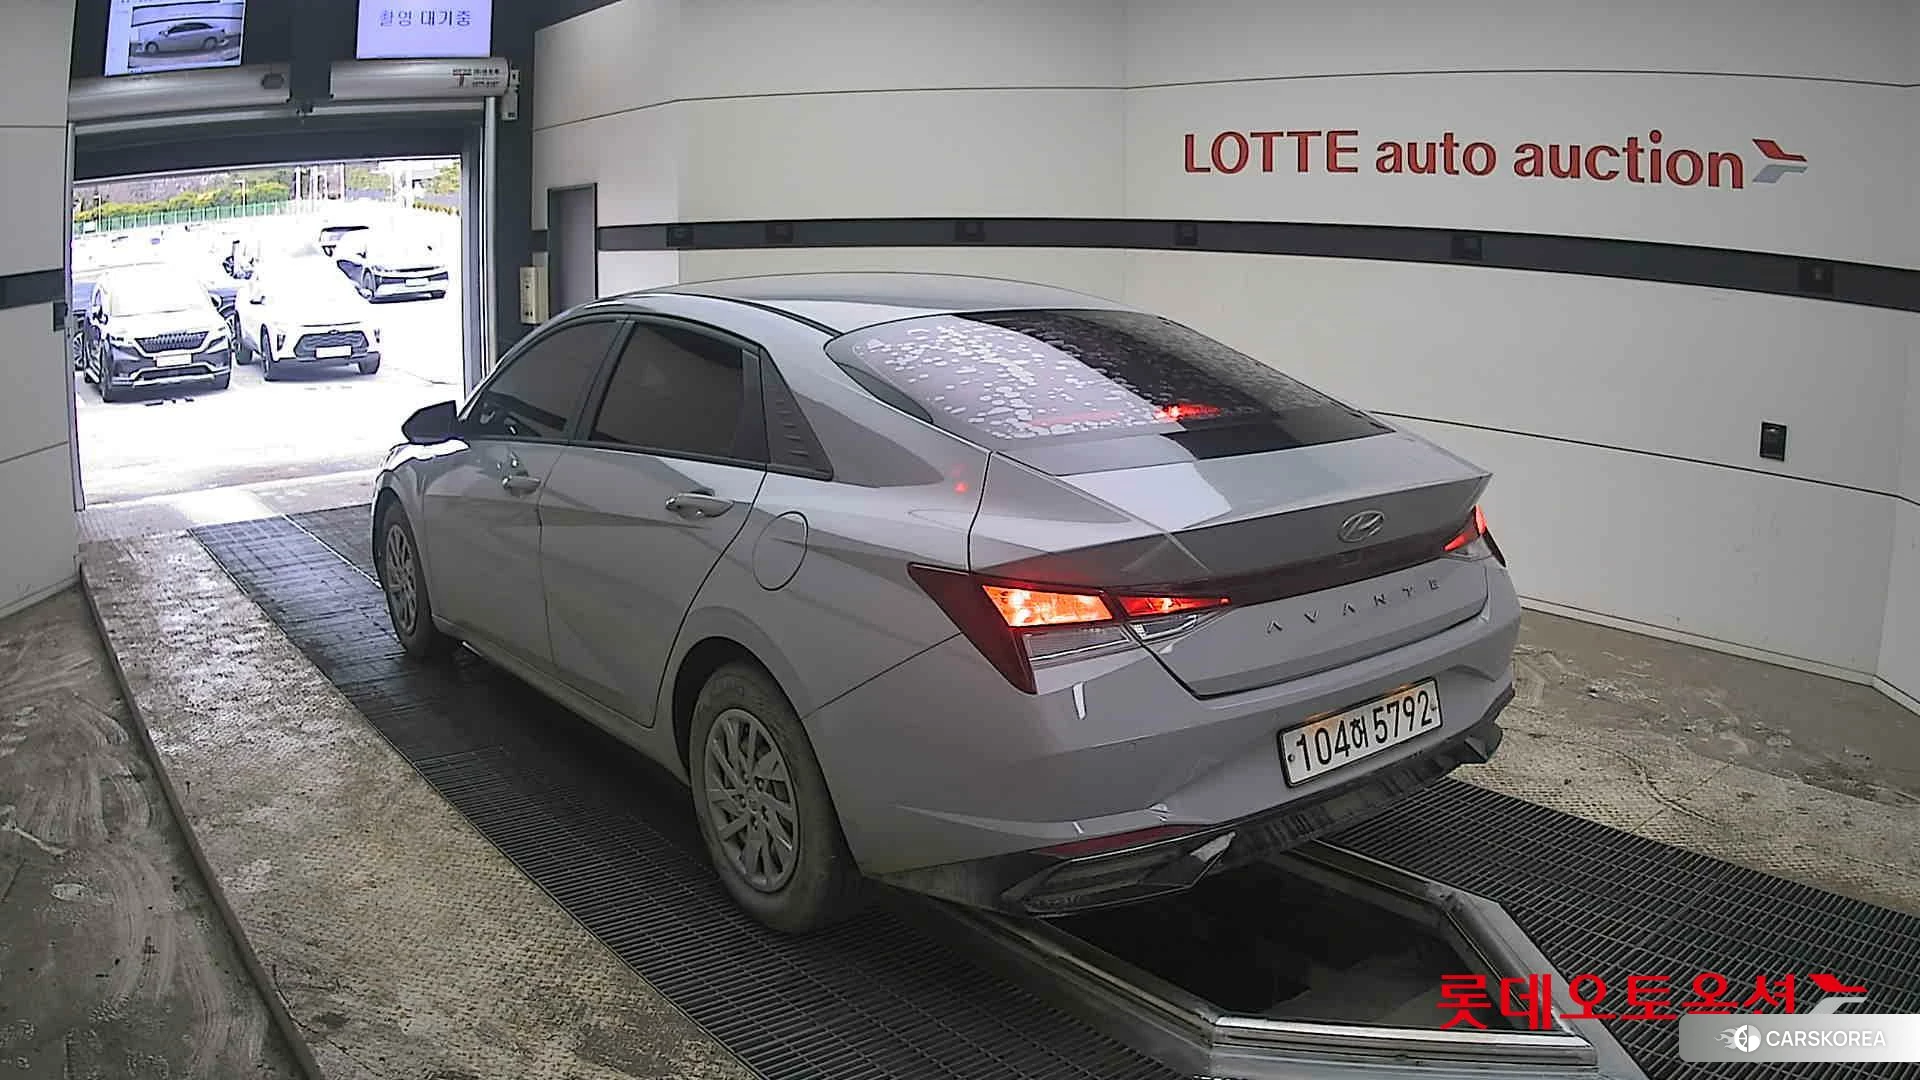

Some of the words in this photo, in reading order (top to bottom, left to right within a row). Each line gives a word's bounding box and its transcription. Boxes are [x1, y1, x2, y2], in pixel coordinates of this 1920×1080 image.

[420, 10, 471, 27] 대기중
[1184, 130, 1359, 174] LOTTE
[1375, 132, 1497, 176] auto
[1513, 130, 1744, 189] auction
[1265, 578, 1441, 635] AVANTE
